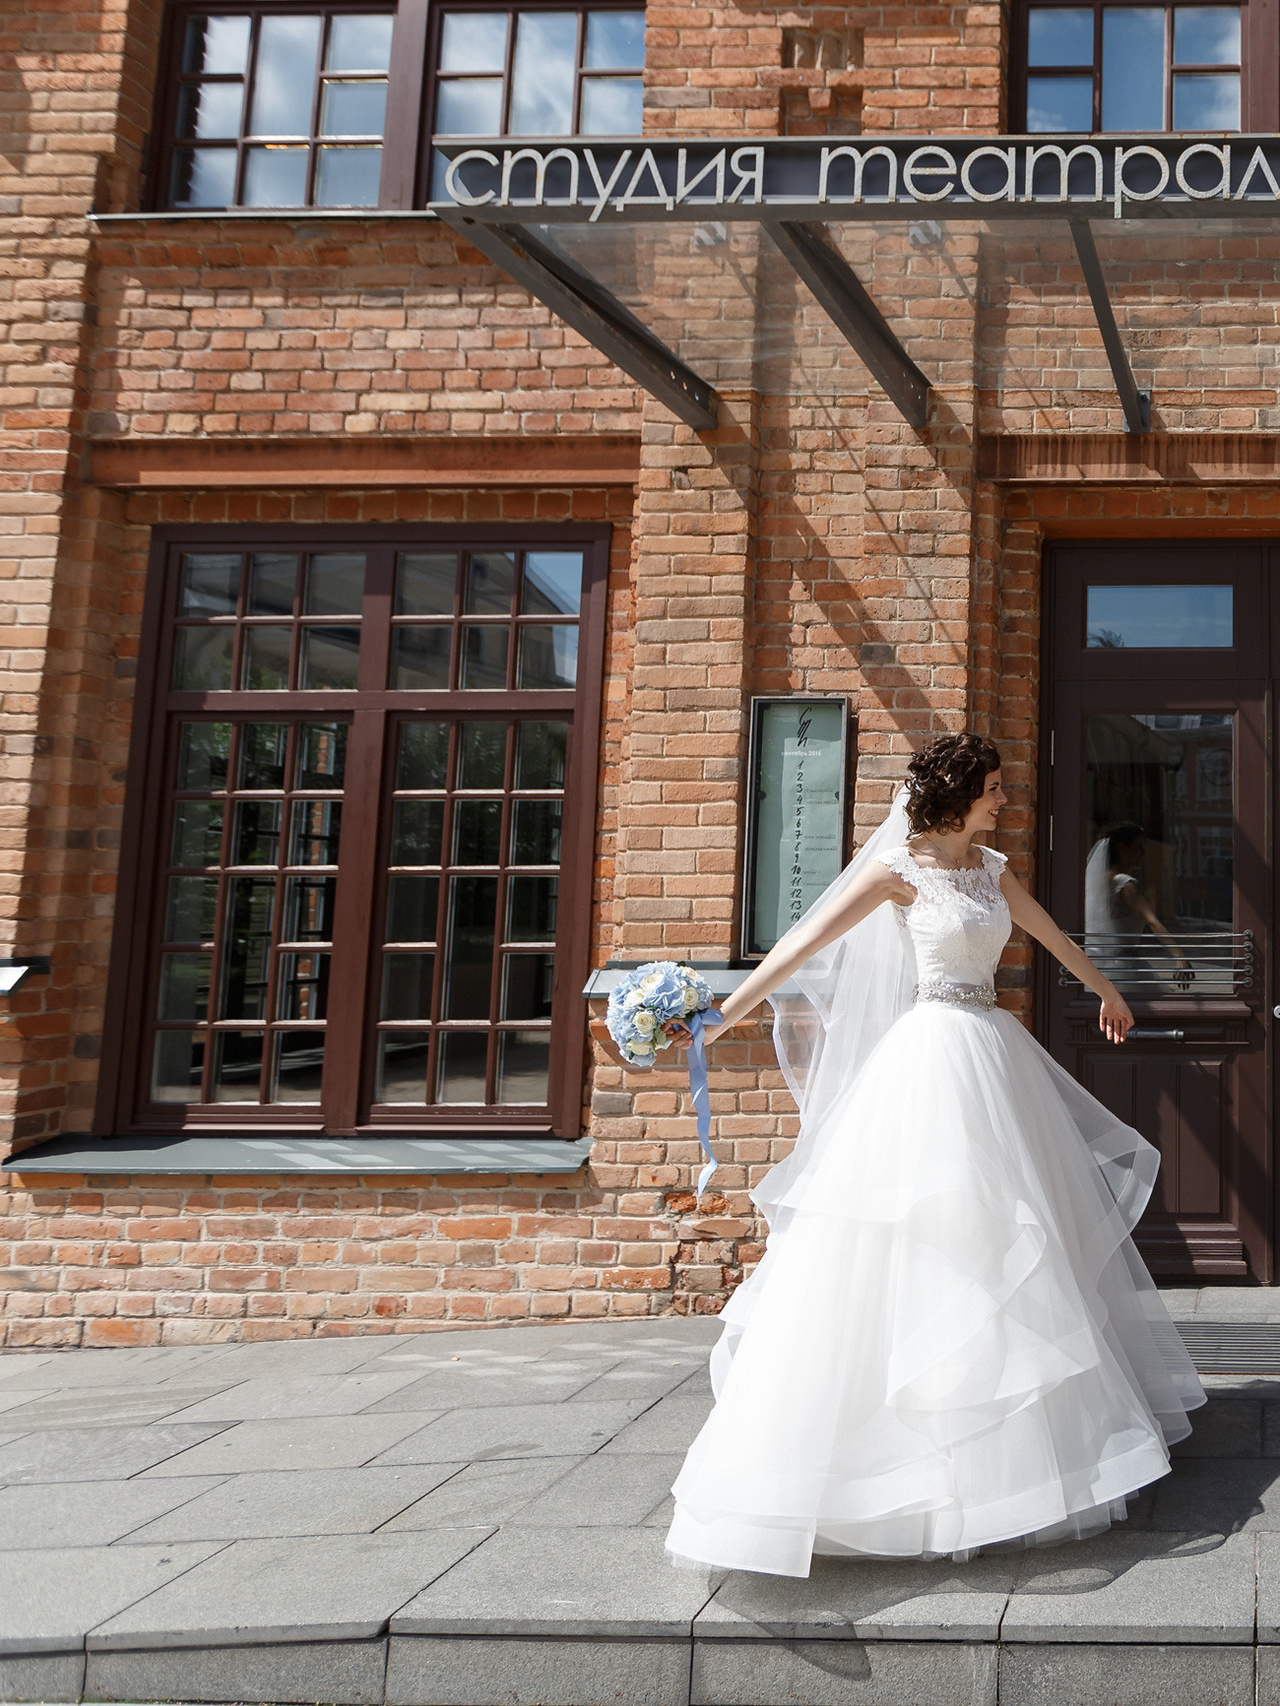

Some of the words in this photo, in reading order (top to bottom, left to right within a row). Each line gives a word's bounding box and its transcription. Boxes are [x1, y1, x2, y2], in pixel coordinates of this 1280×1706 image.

[444, 145, 765, 223] студия
[797, 760, 804, 769] 1
[797, 772, 804, 781] 2
[796, 784, 803, 793] 3
[796, 795, 803, 804] 4
[796, 806, 804, 816] 5
[796, 818, 802, 828] 6
[795, 830, 802, 839] 7
[790, 865, 802, 875] 10
[790, 877, 802, 886] 11
[789, 889, 802, 898] 12
[789, 900, 802, 910] 13
